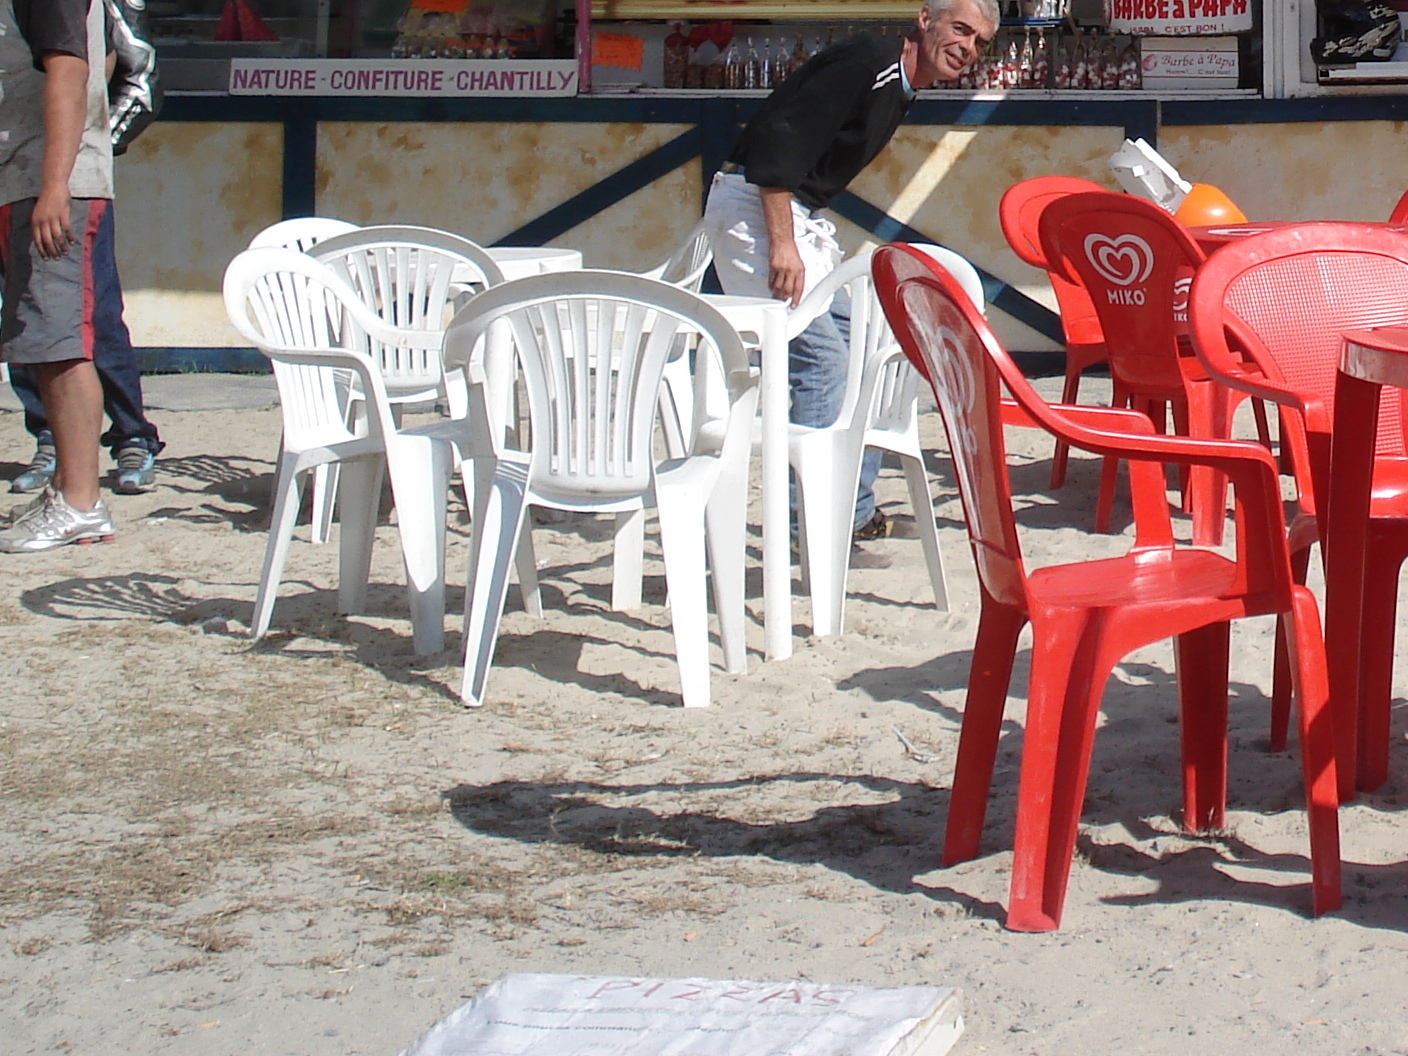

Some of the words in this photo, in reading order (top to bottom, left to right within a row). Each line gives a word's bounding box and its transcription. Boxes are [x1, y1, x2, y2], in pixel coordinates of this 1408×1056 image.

[232, 69, 316, 90] NATURE
[330, 70, 444, 90] CONFITURE
[456, 70, 575, 91] CHANTILLY
[1107, 289, 1145, 306] MIKO
[586, 979, 858, 1007] PIZZAS
